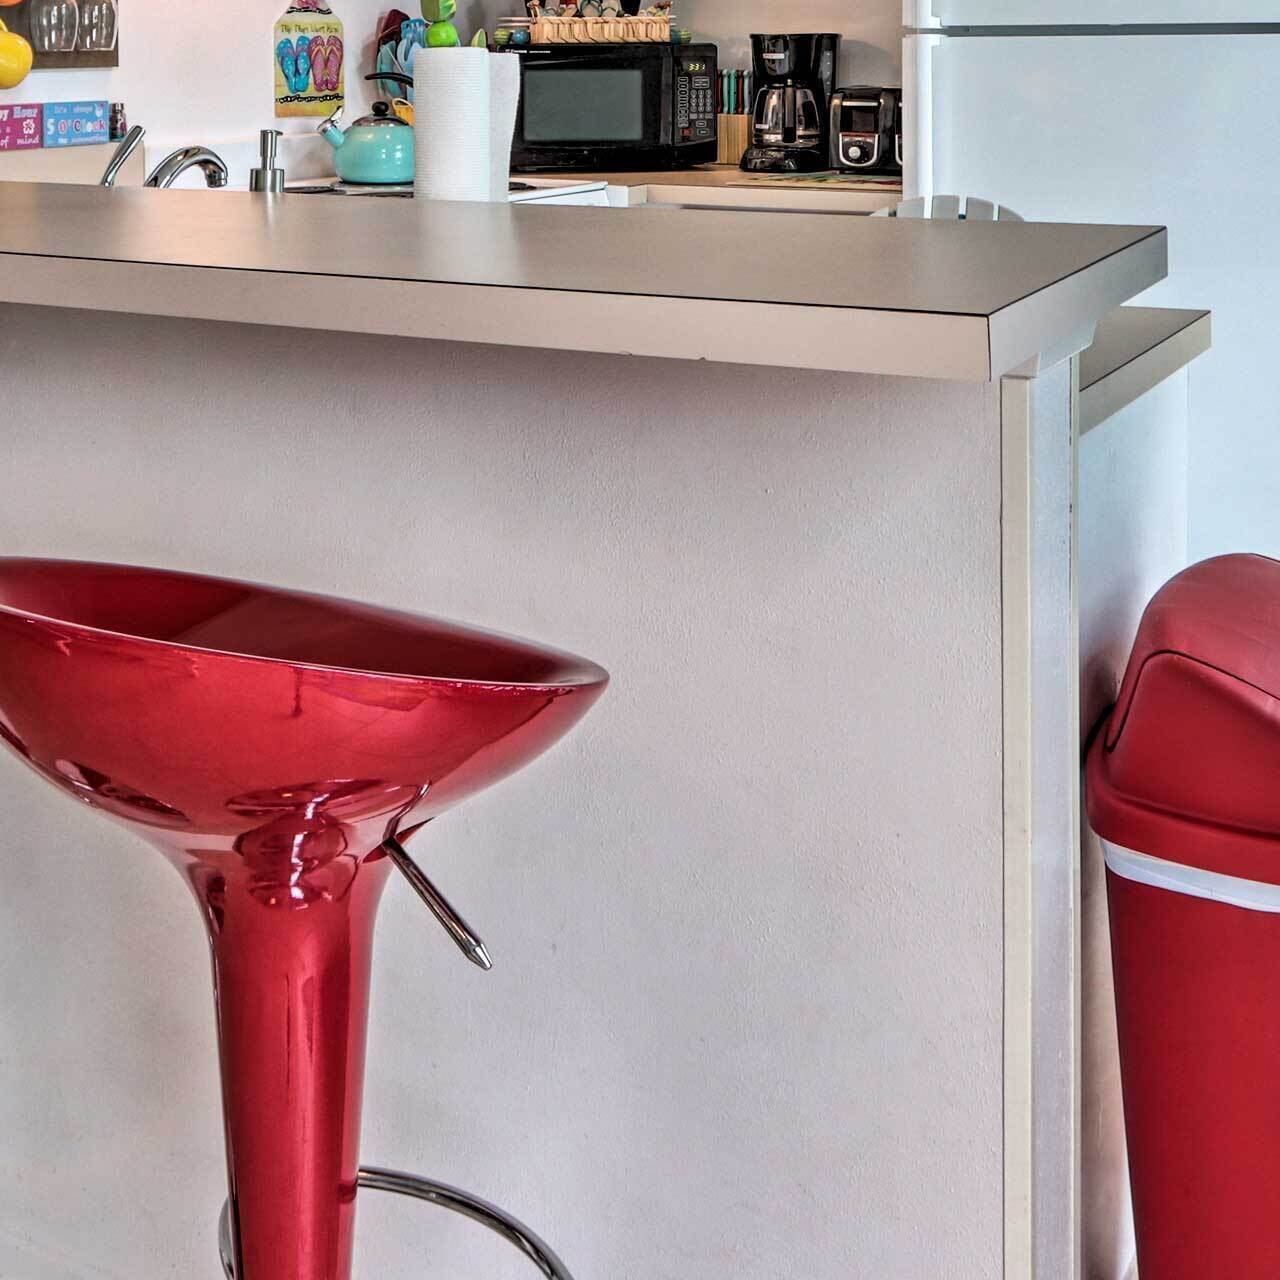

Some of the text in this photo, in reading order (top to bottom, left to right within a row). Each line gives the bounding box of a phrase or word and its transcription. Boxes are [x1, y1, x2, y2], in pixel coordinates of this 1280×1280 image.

[13, 105, 38, 119] Hour
[0, 136, 9, 148] of
[17, 135, 39, 146] mind
